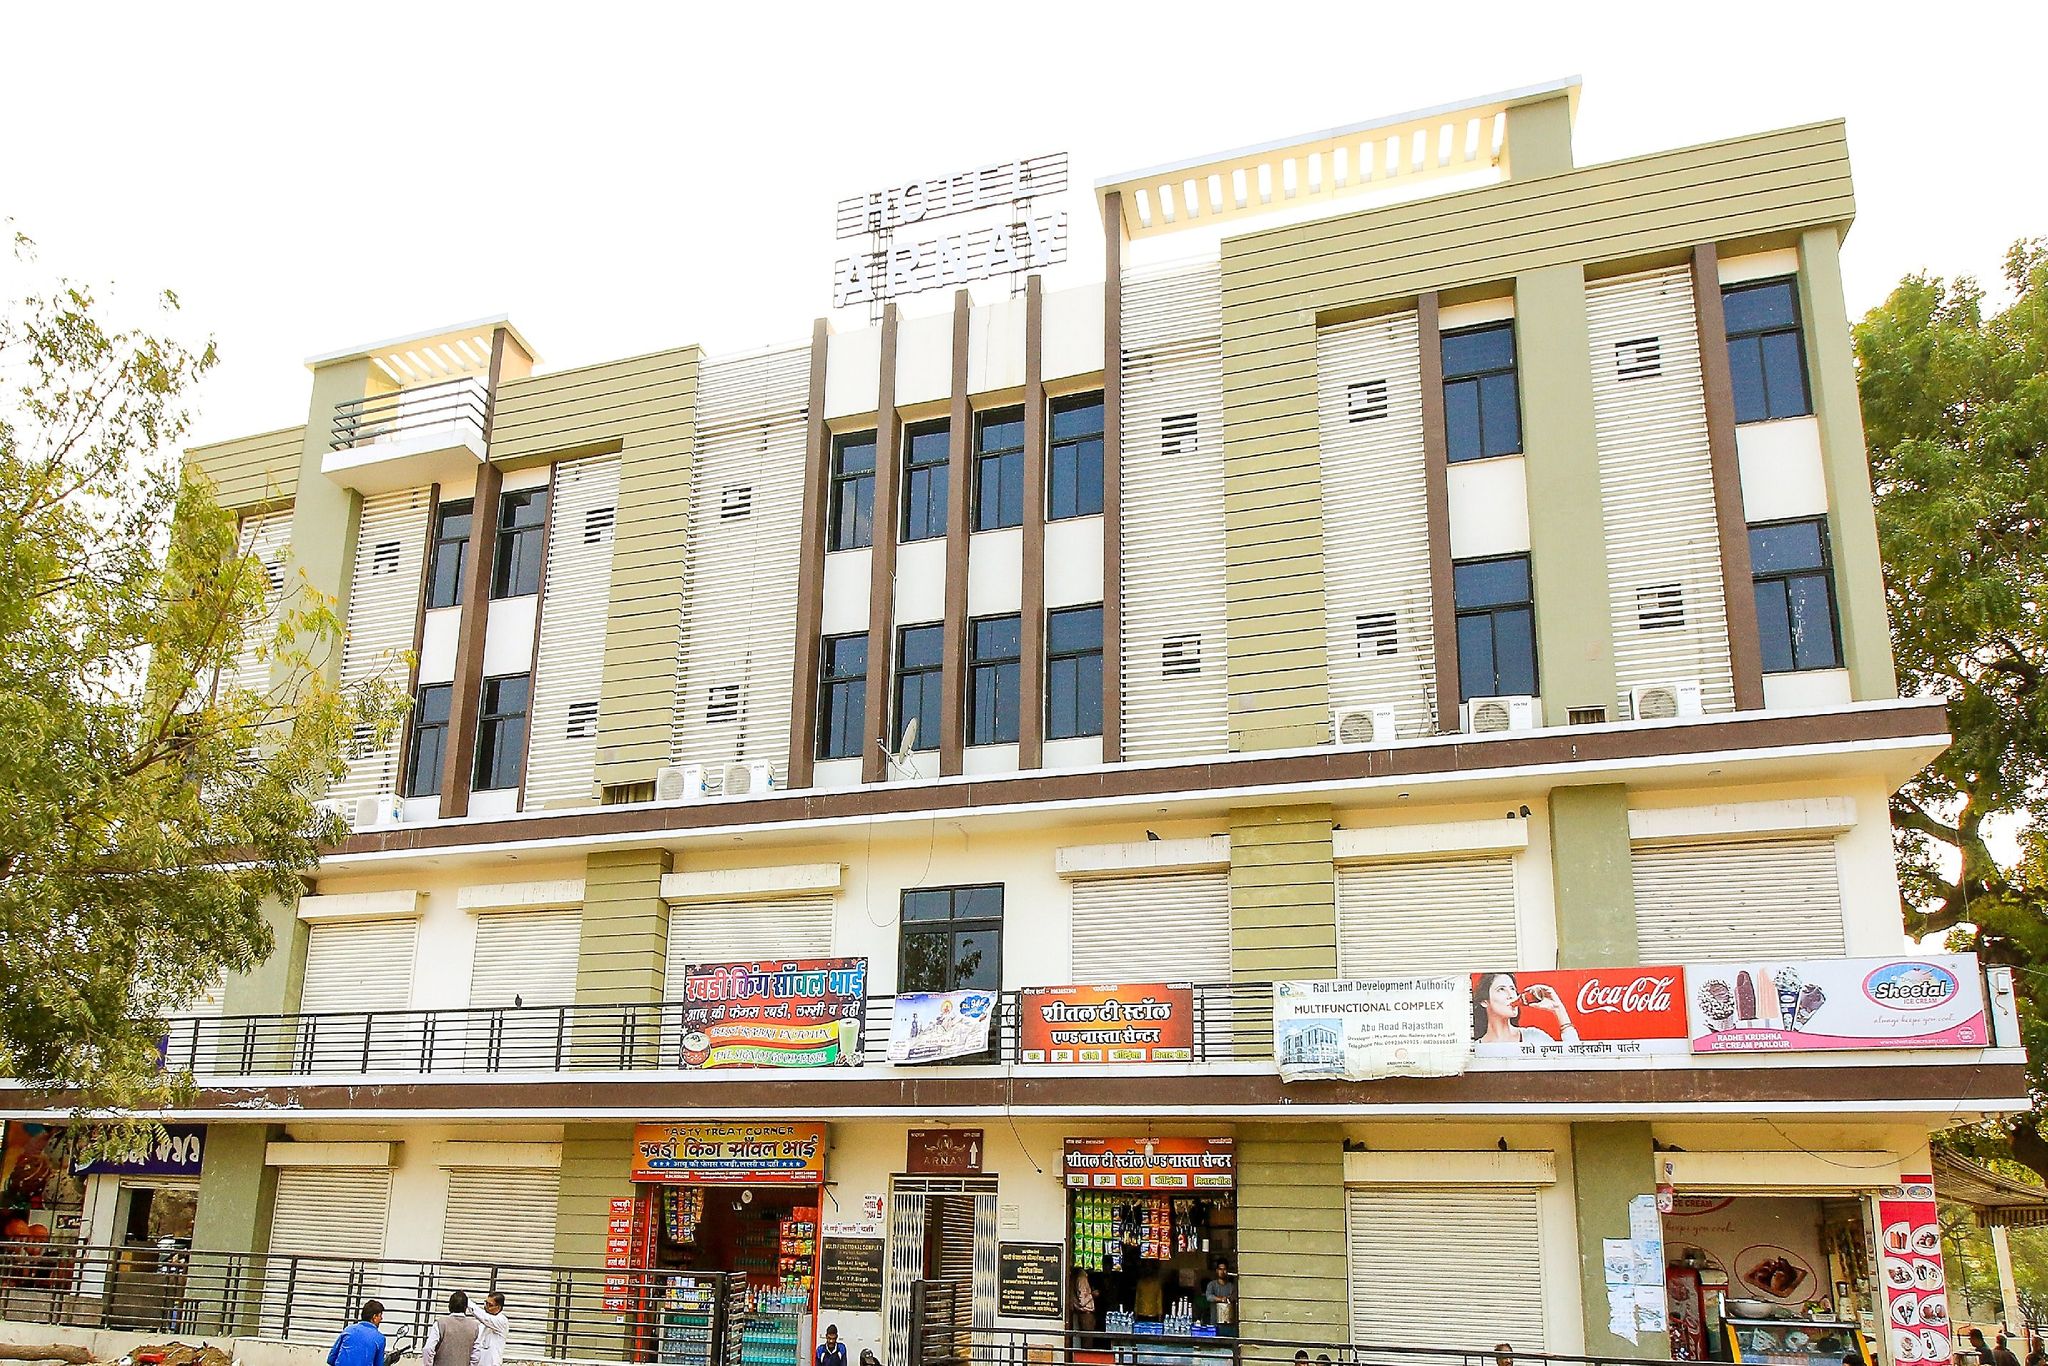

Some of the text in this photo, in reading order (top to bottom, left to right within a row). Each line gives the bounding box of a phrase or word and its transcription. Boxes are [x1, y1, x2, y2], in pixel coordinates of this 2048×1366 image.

[862, 158, 1036, 232] HOTEL
[836, 210, 1063, 308] ARNAV
[730, 964, 771, 999] किंग
[829, 960, 866, 998] भाई
[1312, 979, 1456, 993] Rail Land Development Authority
[1576, 975, 1676, 1015] Coca-Cola
[1876, 980, 1947, 998] Sheetal
[1294, 1000, 1445, 1015] MULTIFUNCTIONAL COMPLEX
[1915, 997, 1938, 1005] CREAM
[1041, 997, 1172, 1023] शीतल टी स्टॉल
[1360, 1021, 1444, 1033] Abu Road Rajasthan
[797, 1028, 833, 1042] TOWN
[1051, 1030, 1081, 1045] एण्ड
[1123, 1025, 1161, 1043] सेन्टर
[1717, 1033, 1782, 1042] RADHE KRUSHNA
[1521, 1044, 1536, 1055] राधे
[1568, 1042, 1612, 1056] आईसक्रीम
[1617, 1041, 1641, 1054] पार्लर
[1711, 1040, 1791, 1050] ICE CREAM PARLOUR
[664, 1126, 795, 1136] TASTY TREAT CORNER
[683, 1136, 724, 1158] किंग
[782, 1134, 819, 1159] भाई
[923, 1156, 964, 1165] ARNAV
[1066, 1150, 1101, 1168] शीतल
[1101, 1150, 1115, 1168] टी
[1115, 1149, 1146, 1168] स्टॉल
[1202, 1150, 1232, 1168] सेन्टर
[1674, 1199, 1713, 1207] CE CREAM
